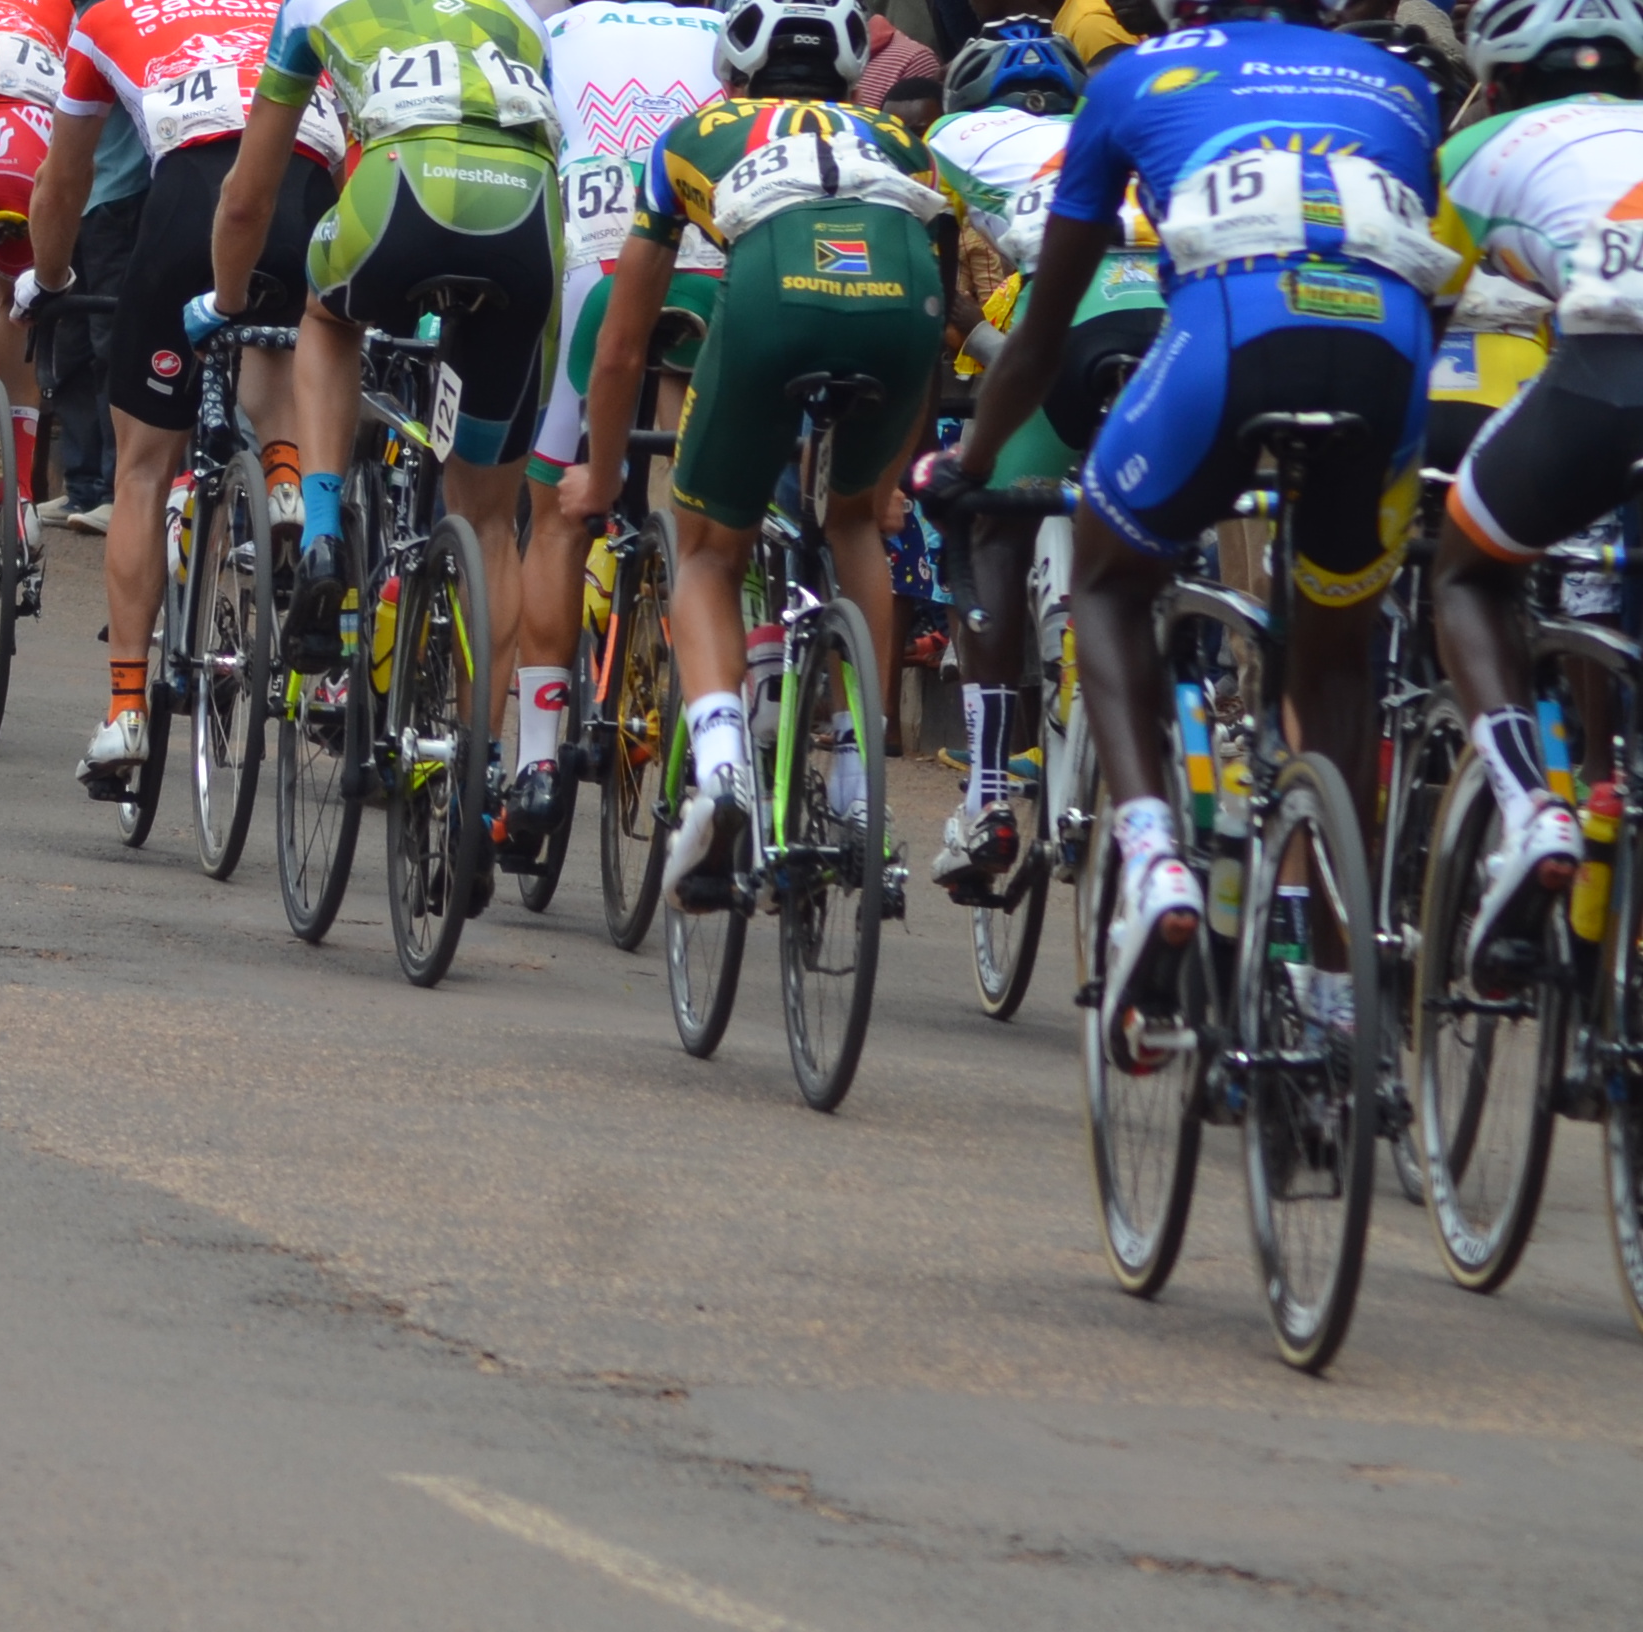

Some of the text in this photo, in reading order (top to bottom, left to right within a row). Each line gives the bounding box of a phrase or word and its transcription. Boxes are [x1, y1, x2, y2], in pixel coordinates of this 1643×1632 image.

[137, 9, 277, 37] le Départeme
[597, 12, 721, 34] ALGER
[9, 36, 55, 77] 73
[371, 48, 442, 94] 121
[165, 70, 218, 106] 74
[422, 162, 528, 189] LowestRates
[731, 144, 789, 193] 83
[1205, 157, 1263, 216] 15
[562, 165, 628, 223] 152
[1602, 227, 1643, 281] 6
[782, 275, 904, 297] SOUTH AFRICA
[436, 377, 457, 445] 121
